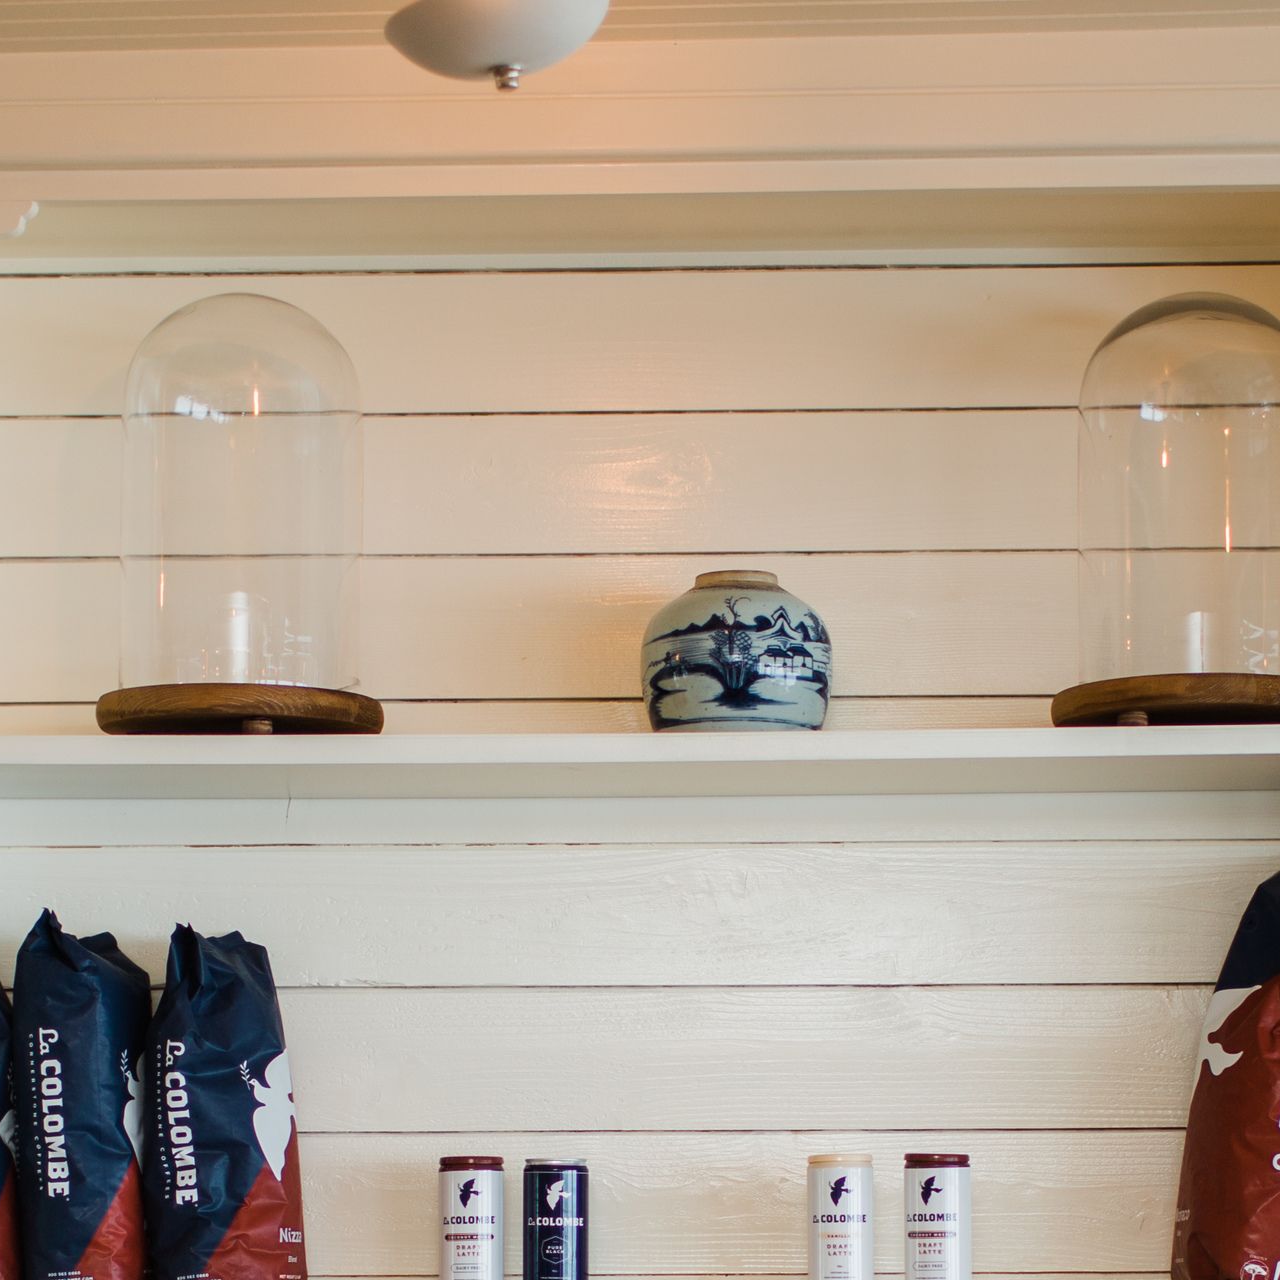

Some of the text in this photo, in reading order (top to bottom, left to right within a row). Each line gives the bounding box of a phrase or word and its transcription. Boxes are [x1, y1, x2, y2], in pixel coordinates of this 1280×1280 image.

[39, 1027, 70, 1198] La COLOMBE
[165, 1039, 198, 1206] La COLOMBE
[536, 1216, 584, 1226] COLOMBE
[912, 1213, 957, 1222] COLOMBE
